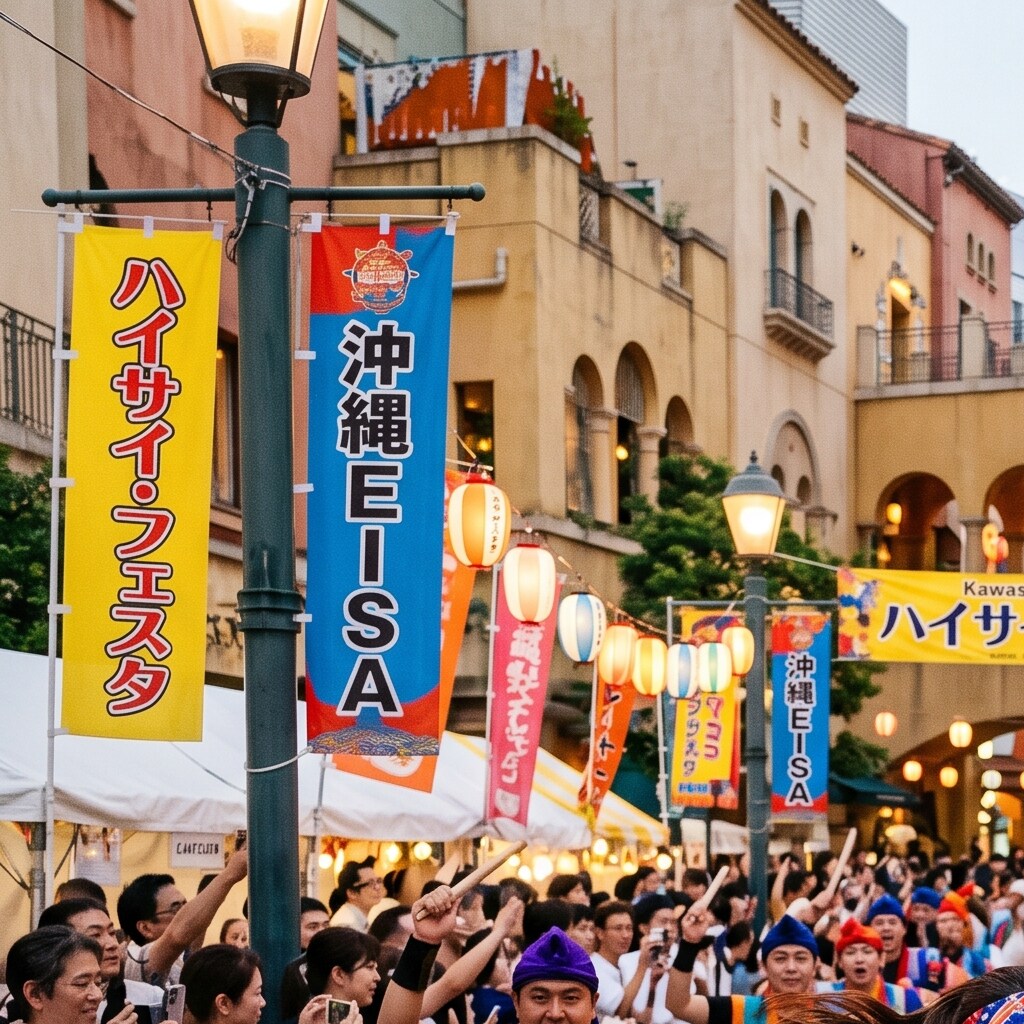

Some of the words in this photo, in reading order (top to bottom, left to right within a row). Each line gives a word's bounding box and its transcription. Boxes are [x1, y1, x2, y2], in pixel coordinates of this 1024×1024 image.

[106, 257, 186, 717] ハイサイ・フェスタ
[338, 321, 414, 717] 沖縄EISA
[786, 653, 815, 804] 沖縄EISA
